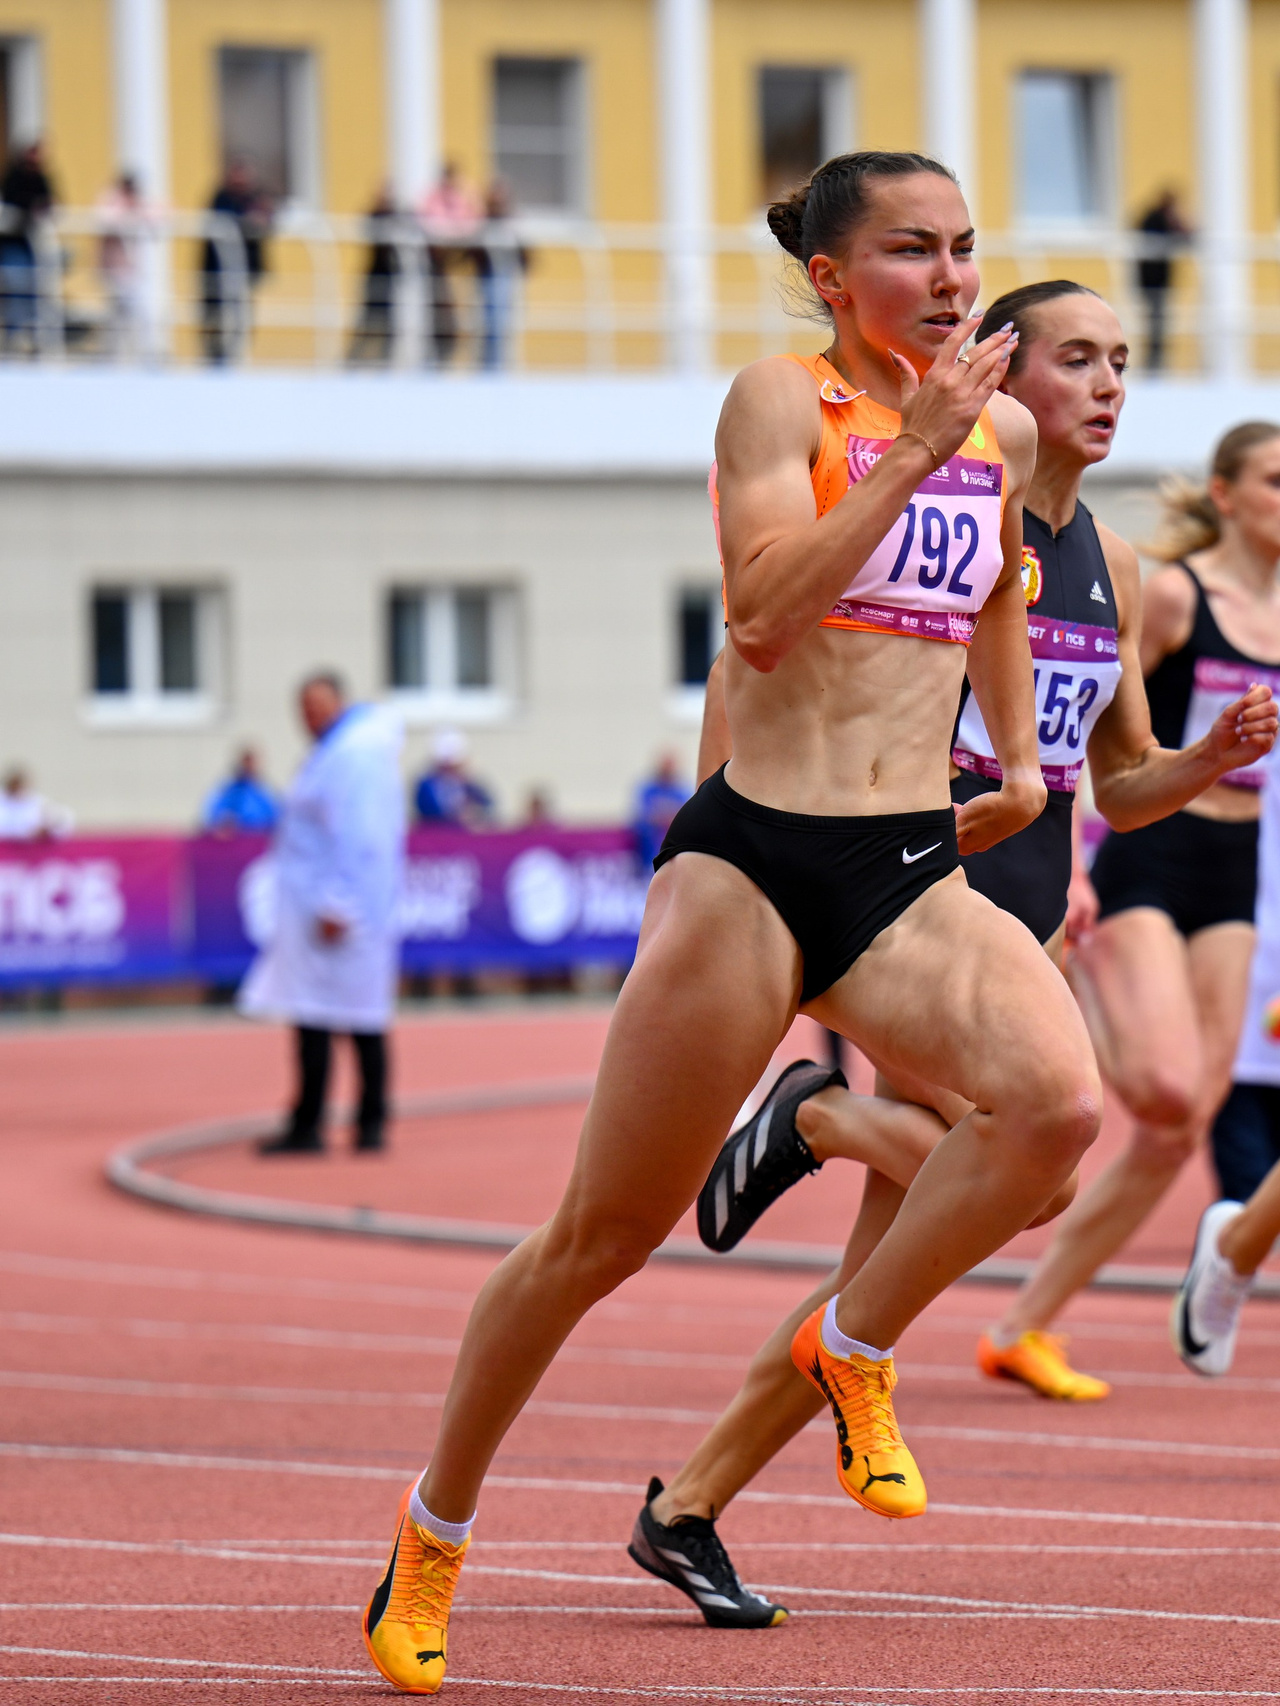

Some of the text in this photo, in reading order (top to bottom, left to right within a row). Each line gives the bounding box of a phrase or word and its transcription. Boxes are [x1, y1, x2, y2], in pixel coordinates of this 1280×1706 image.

[969, 477, 995, 488] ЛИЗИНГ
[887, 502, 979, 597] 792
[1065, 632, 1086, 647] ПСБ
